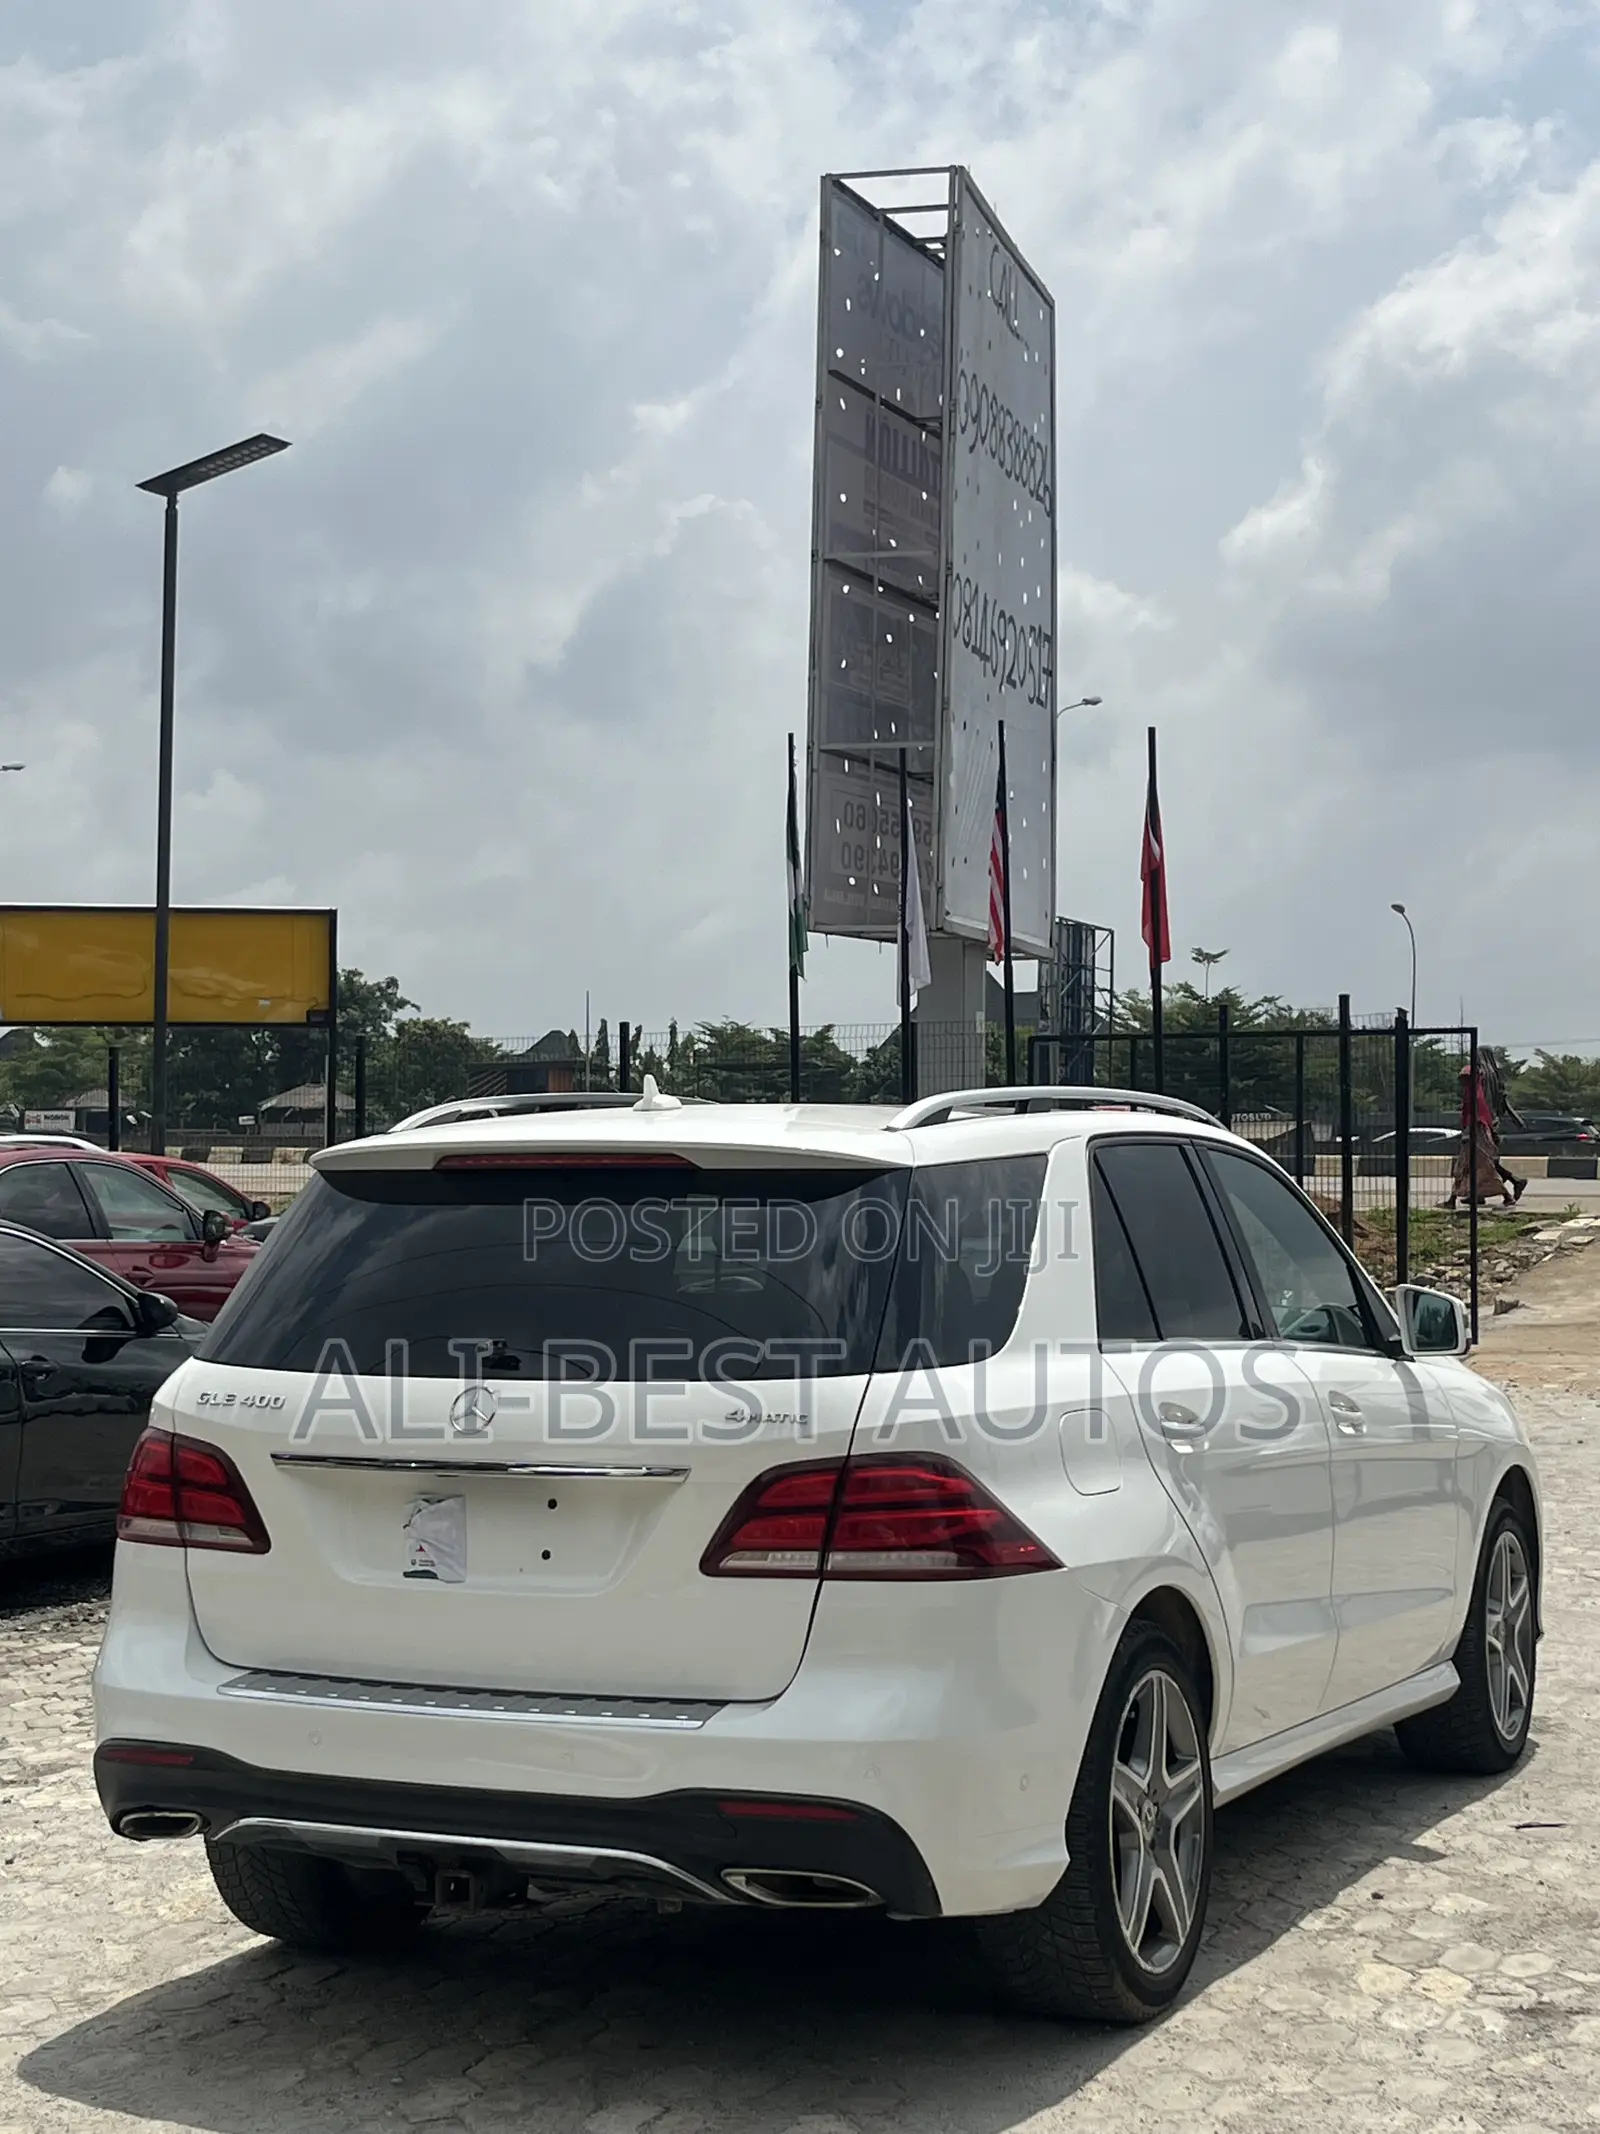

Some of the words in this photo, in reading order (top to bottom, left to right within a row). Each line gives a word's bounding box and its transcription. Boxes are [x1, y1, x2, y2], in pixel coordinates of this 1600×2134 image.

[197, 1392, 237, 1406] GLE
[240, 1394, 286, 1410] 400
[725, 1408, 809, 1425] 4MATIC
